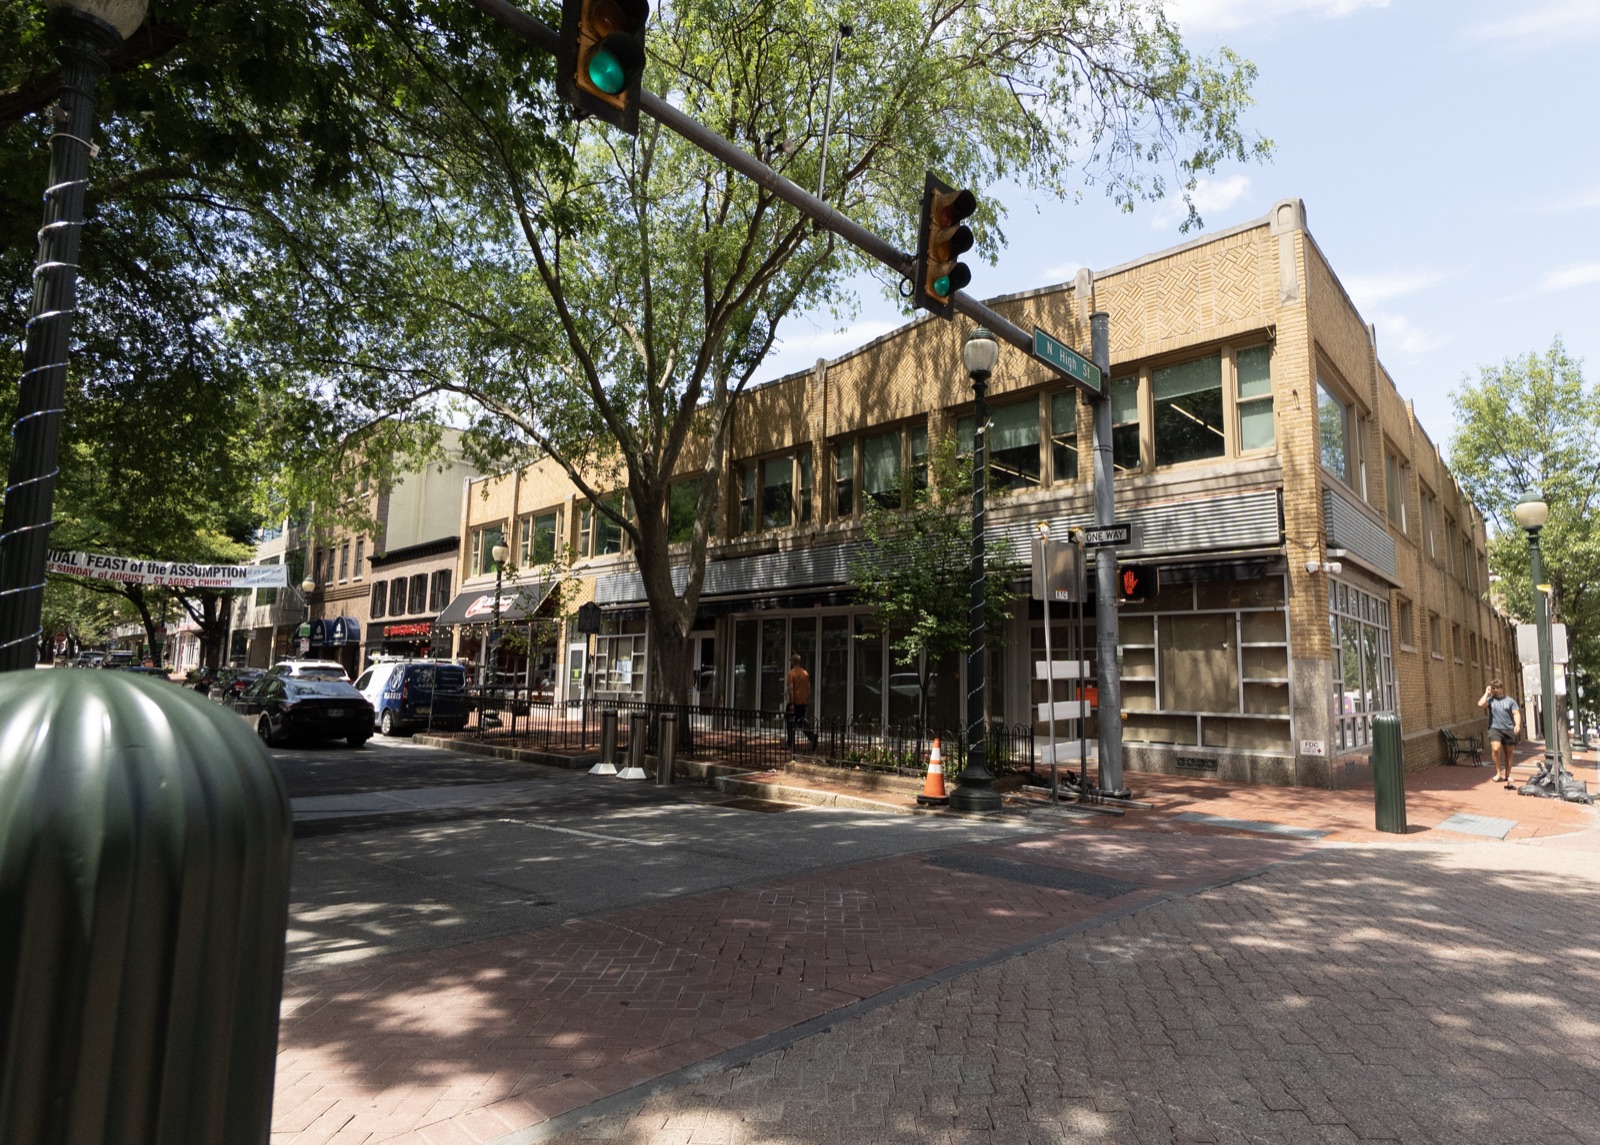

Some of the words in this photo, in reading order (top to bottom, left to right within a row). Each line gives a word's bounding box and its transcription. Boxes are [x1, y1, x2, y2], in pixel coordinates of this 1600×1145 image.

[1046, 341, 1052, 355] N
[1059, 348, 1077, 372] High
[1082, 363, 1091, 379] St
[1086, 532, 1103, 542] ONE
[1105, 530, 1124, 540] WAY
[57, 564, 94, 577] SUNDAY
[97, 571, 108, 580] of
[109, 572, 145, 584] AUGUST
[168, 578, 196, 587] AGNES
[198, 579, 232, 587] CHURCH
[86, 555, 128, 571] FEAST
[130, 562, 144, 573] of
[147, 563, 167, 575] the
[170, 564, 247, 578] ASSUMPTION
